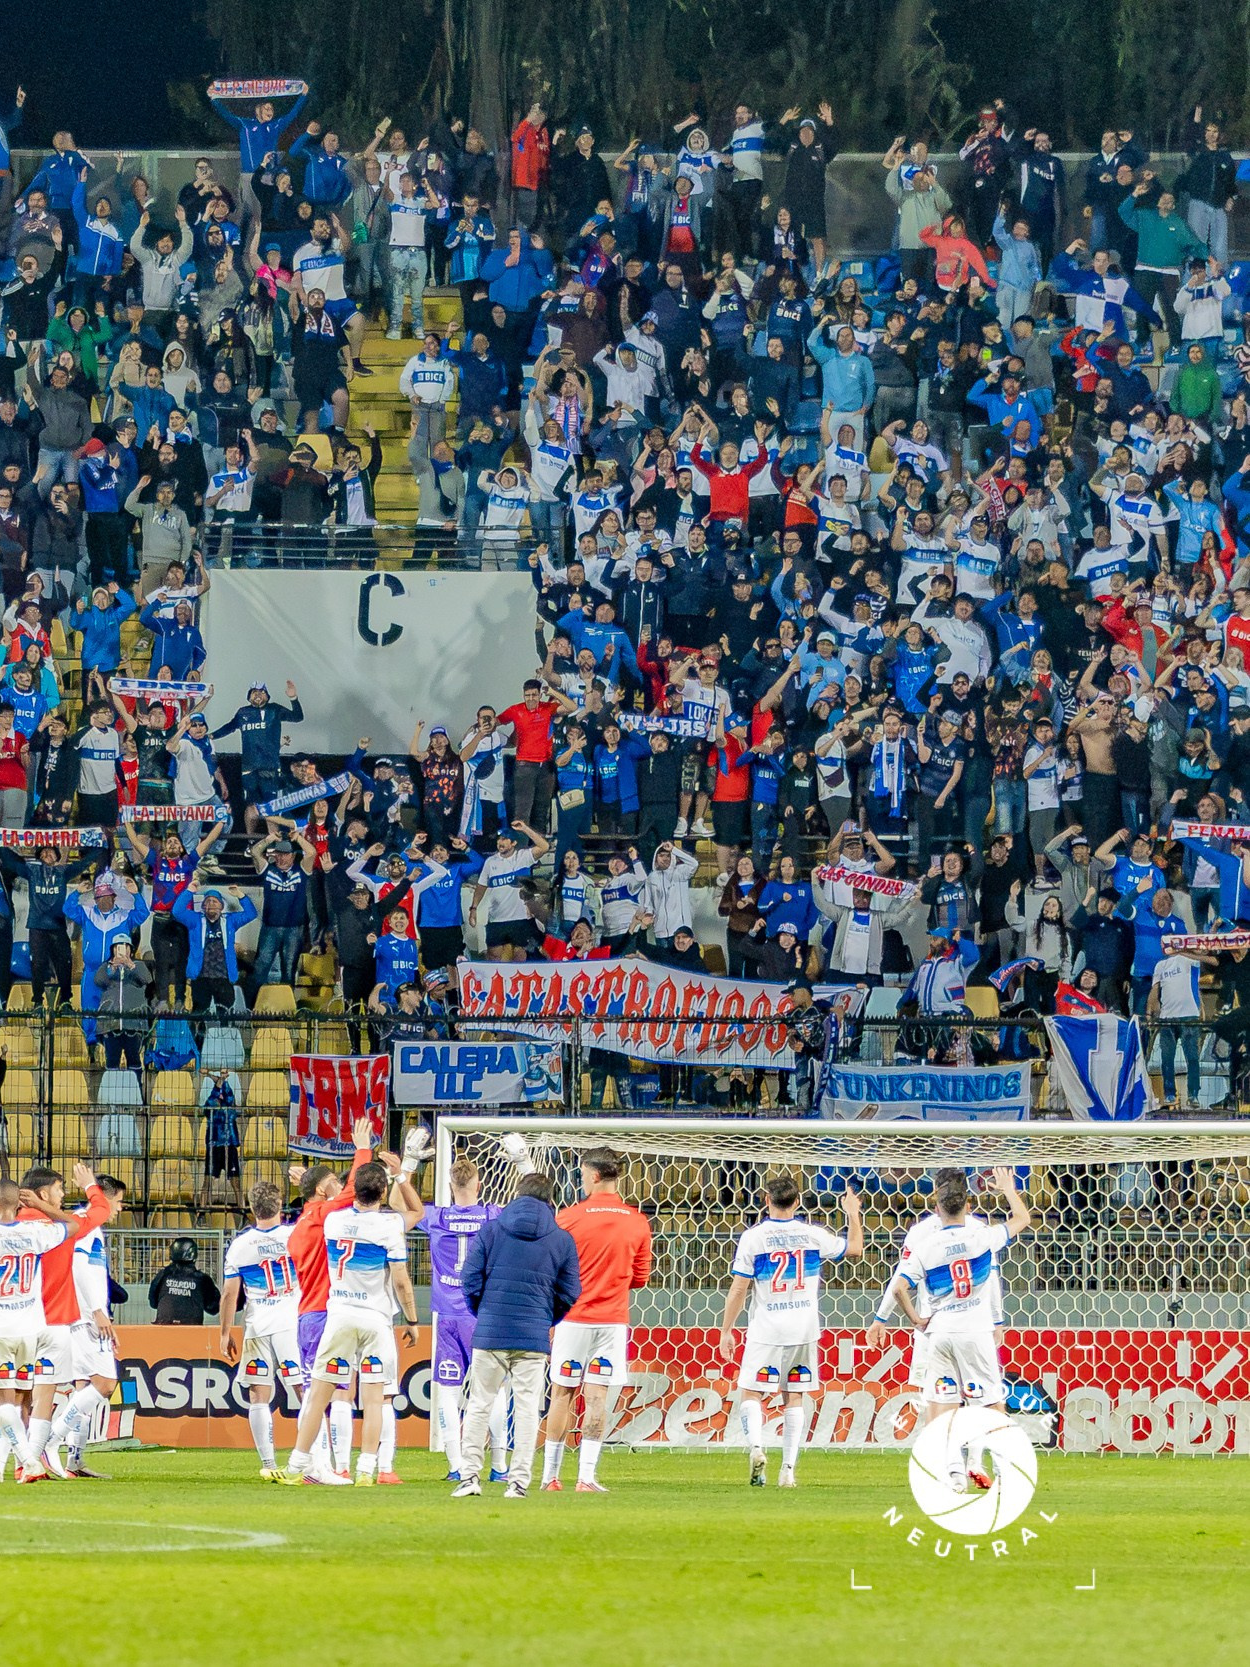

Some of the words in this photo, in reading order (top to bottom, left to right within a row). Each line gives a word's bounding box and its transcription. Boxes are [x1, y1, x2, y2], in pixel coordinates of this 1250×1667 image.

[783, 310, 801, 321] BICE
[425, 373, 443, 381] BICE
[922, 552, 940, 560] BICE
[1102, 563, 1120, 575] BICE
[358, 573, 405, 647] C
[17, 708, 35, 718] BICE
[247, 722, 266, 730] BICE
[133, 806, 150, 820] LA
[154, 805, 215, 821] PINTANA
[1188, 825, 1250, 839] PENAL
[2, 830, 21, 847] LA
[24, 831, 80, 847] CALERA
[165, 873, 185, 882] BICE
[845, 870, 904, 896] CONDES
[41, 886, 59, 895] BICE
[567, 889, 584, 898] BIC
[944, 892, 964, 902] BICE
[400, 961, 414, 969] BIC
[401, 1046, 519, 1073] CALERA
[444, 1213, 487, 1221] LEAPMOTOR
[586, 1208, 630, 1216] LEAPMOTOR
[337, 1238, 356, 1281] 7
[259, 1254, 294, 1298] 11
[770, 1248, 806, 1294] 21
[949, 1258, 973, 1299] 8
[165, 1280, 196, 1290] SEGURIDAD
[168, 1288, 191, 1298] PRIVADA
[767, 1300, 810, 1312] SAMSUNG
